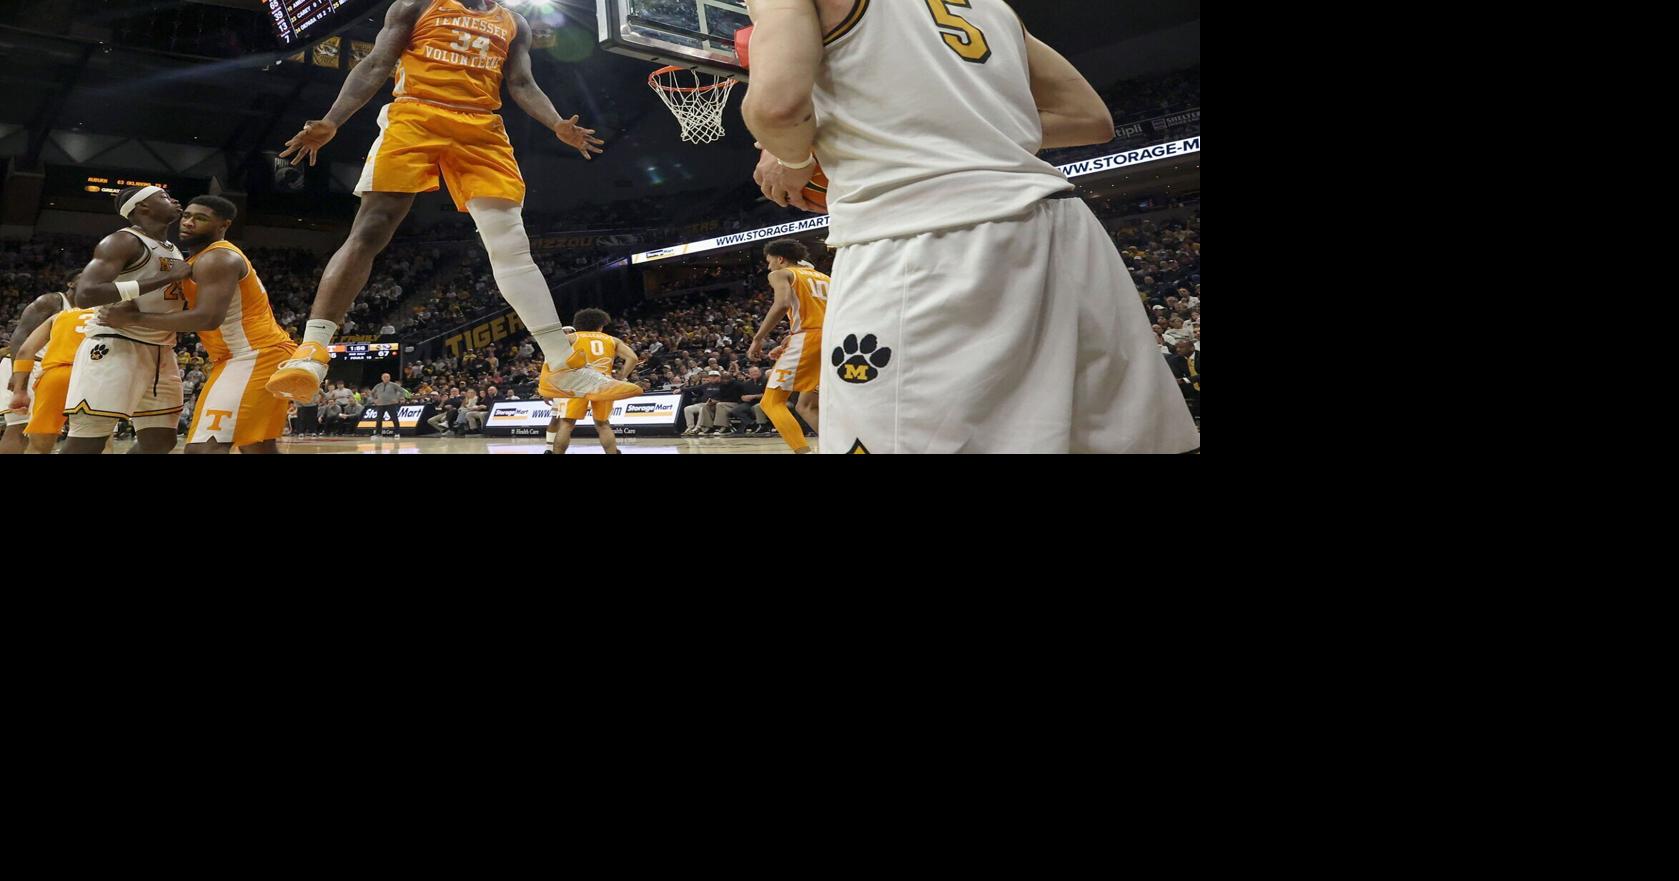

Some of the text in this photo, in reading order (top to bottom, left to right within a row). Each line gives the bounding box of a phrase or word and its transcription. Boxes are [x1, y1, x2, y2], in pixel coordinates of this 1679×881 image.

[435, 16, 508, 40] TENNESSEE
[925, 0, 992, 64] 5
[450, 29, 490, 57] 34
[1114, 123, 1143, 138] tipli
[716, 216, 831, 246] WWW.STORAGE-MART
[590, 340, 604, 356] 0
[776, 369, 792, 382] T
[844, 364, 869, 380] M
[205, 409, 232, 431] T
